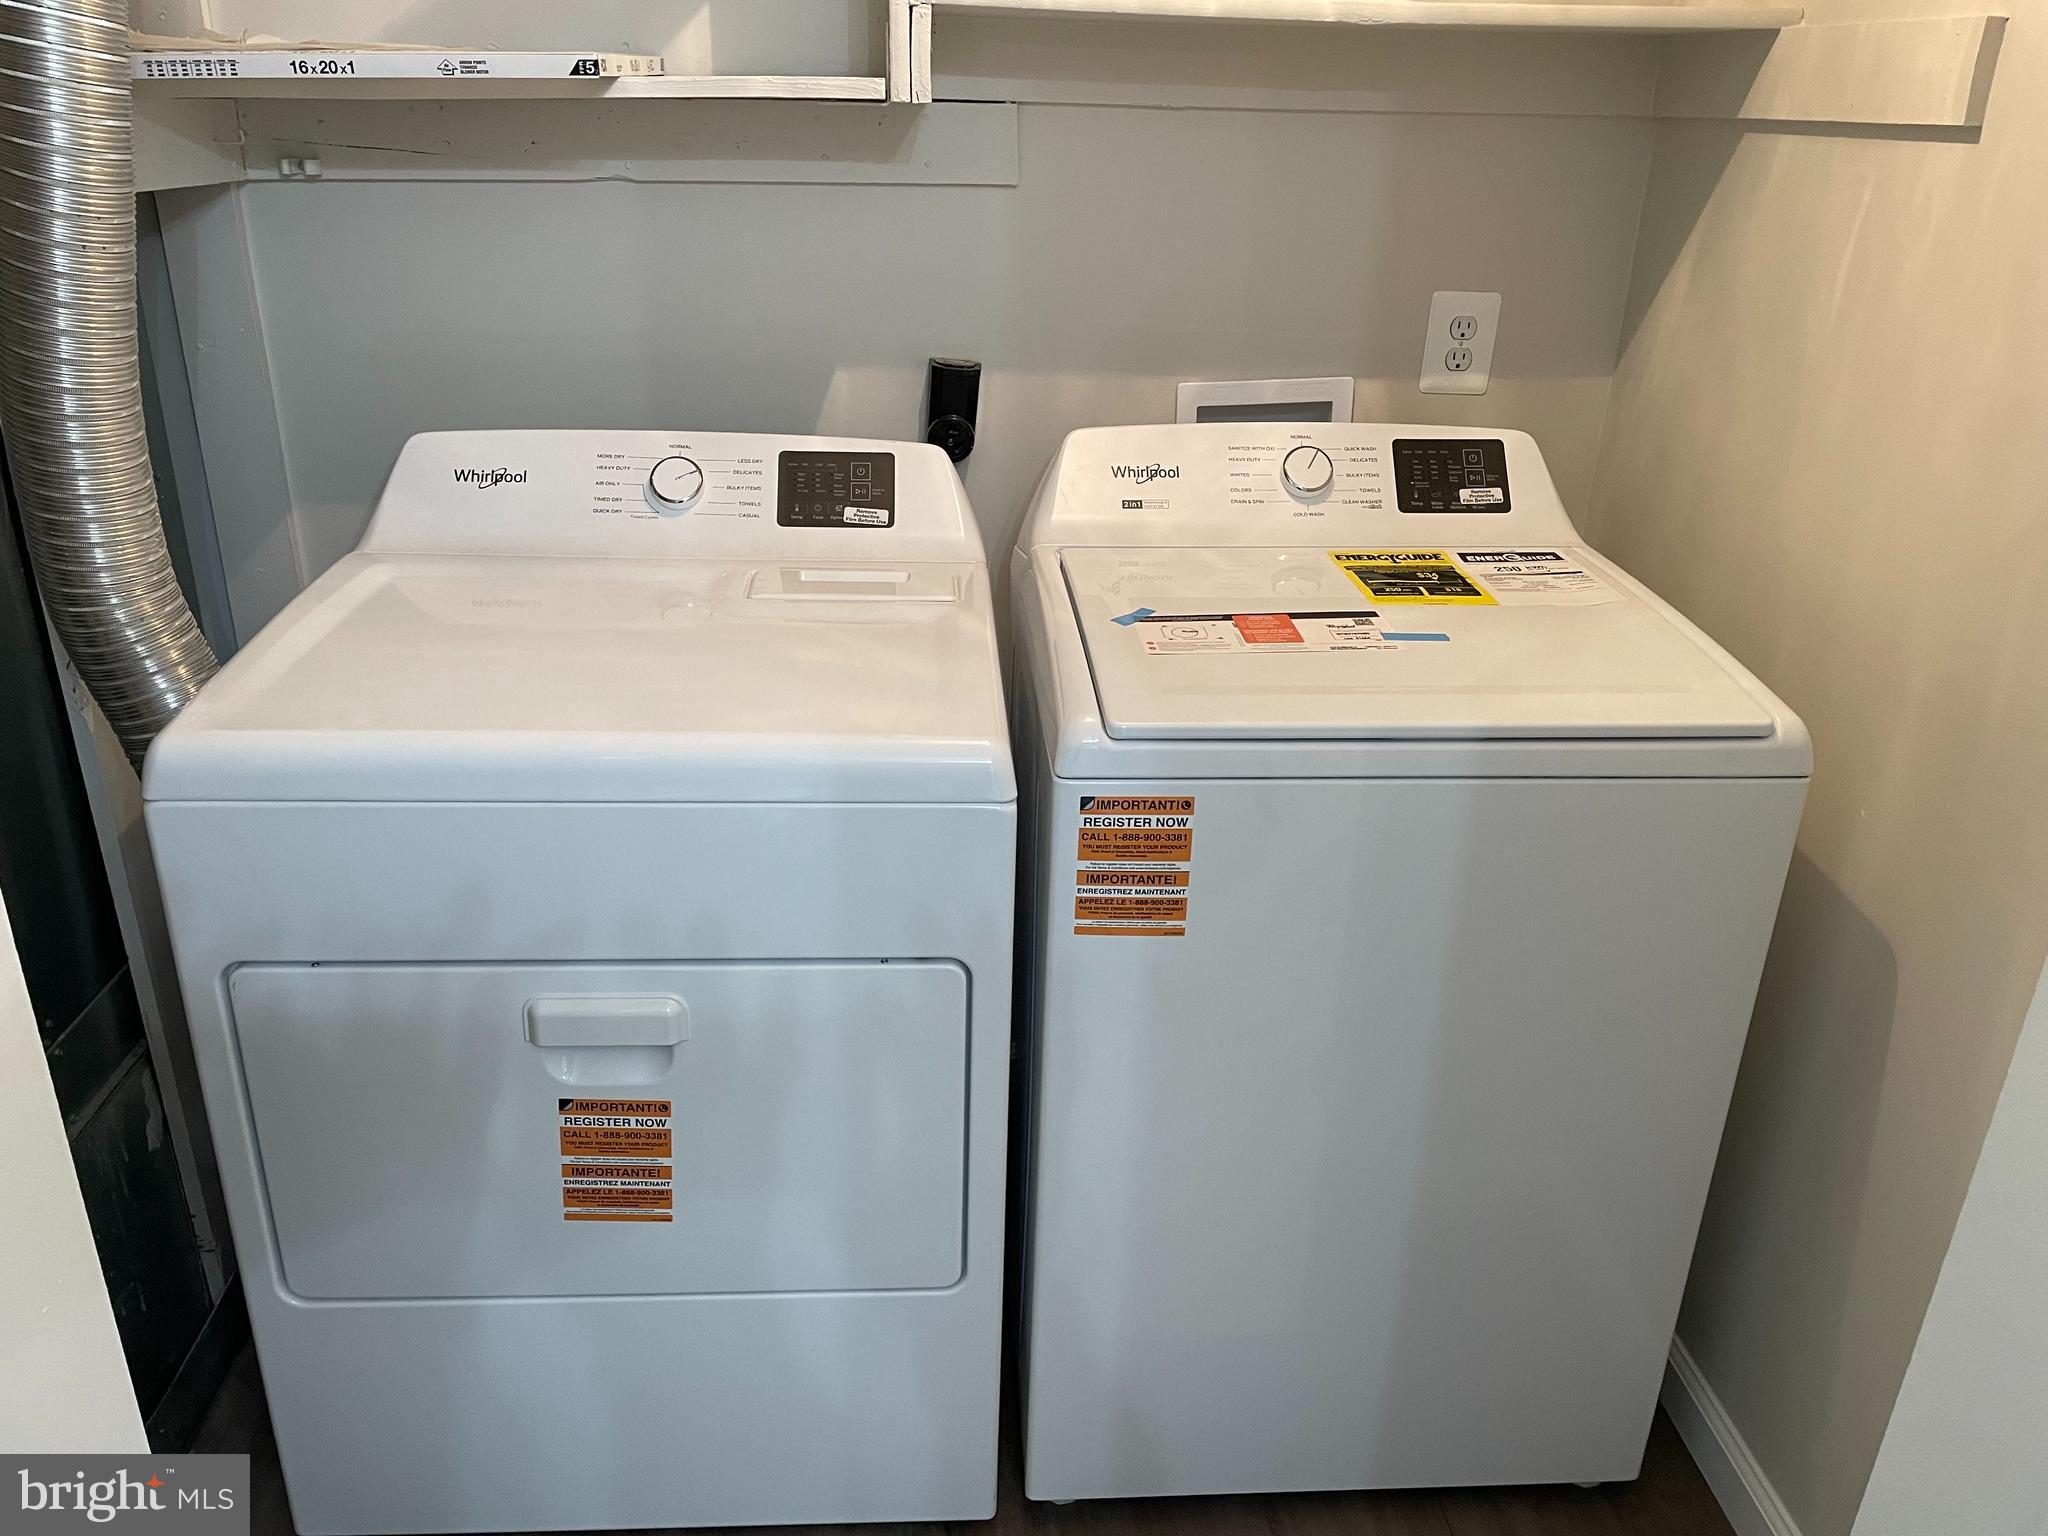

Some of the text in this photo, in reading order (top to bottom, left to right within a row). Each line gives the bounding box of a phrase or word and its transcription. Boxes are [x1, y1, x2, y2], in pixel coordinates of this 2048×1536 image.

[585, 61, 595, 74] 5
[454, 467, 527, 489] Whirlpool
[1110, 463, 1180, 485] Whirlpool
[1096, 800, 1180, 811] IMPORTANT!
[1083, 817, 1189, 828] REGISTER NOW
[1081, 832, 1188, 842] CALL 1-888-900-3381
[1086, 874, 1177, 885] IMPORTANTE!
[1077, 887, 1186, 896] ENREGISTREZ MAINTENANT
[575, 1102, 657, 1113] IMPORTANT!
[564, 1117, 667, 1128] REGISTER NOW
[563, 1130, 668, 1140] CALL 1-888-900-3381
[571, 1167, 661, 1178] IMPORTANTE!
